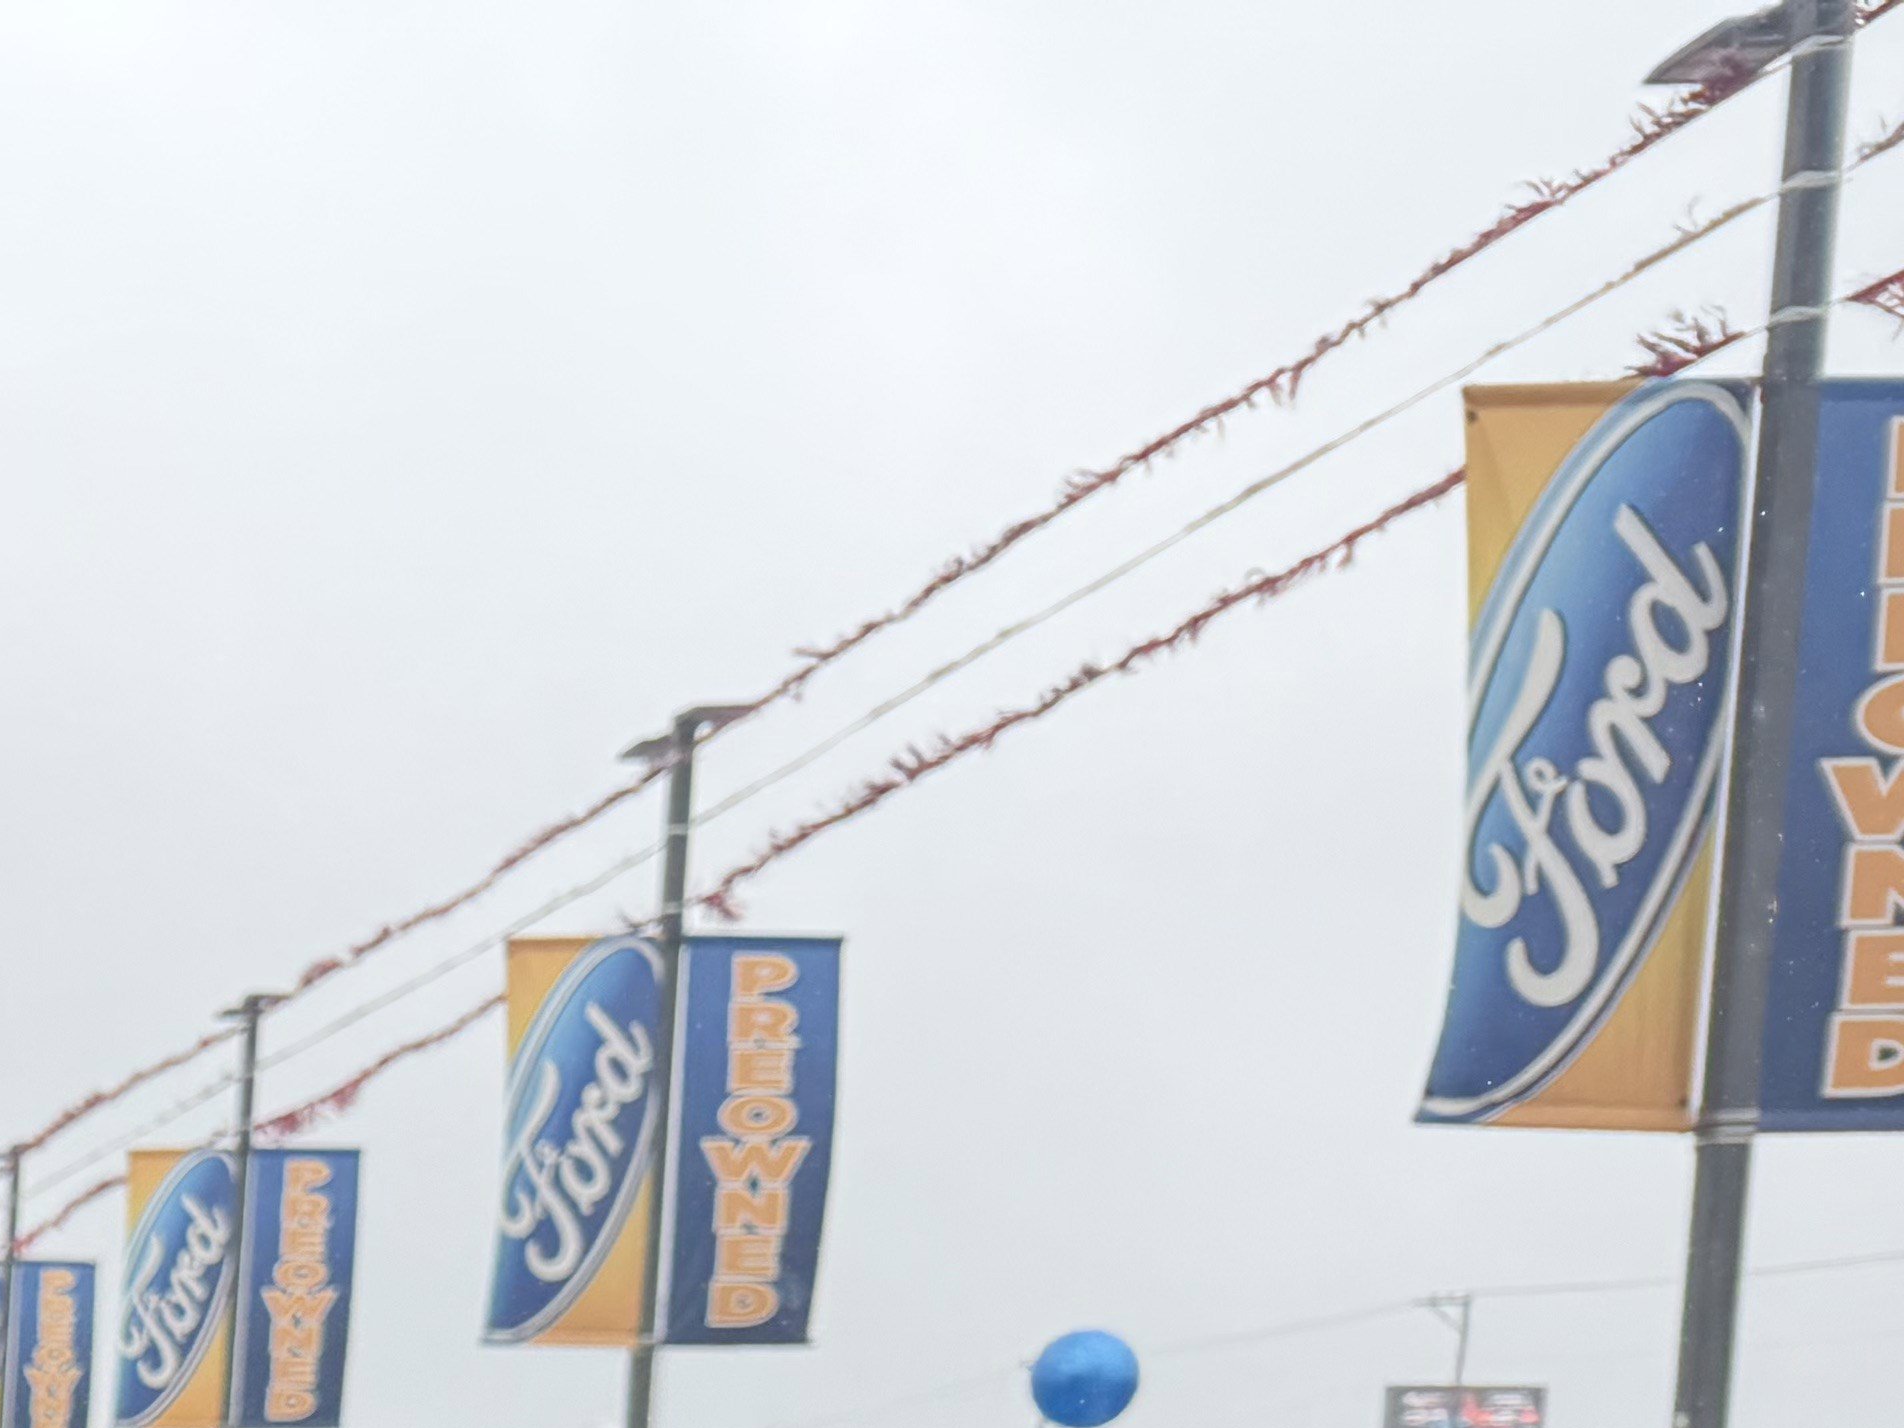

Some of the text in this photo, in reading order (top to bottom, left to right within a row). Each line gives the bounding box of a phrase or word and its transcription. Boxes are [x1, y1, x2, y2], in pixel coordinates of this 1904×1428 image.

[1460, 502, 1729, 1008] Ford
[119, 1193, 231, 1390] Ford
[498, 998, 653, 1284] Ford
[700, 950, 812, 1329] PREOWNED
